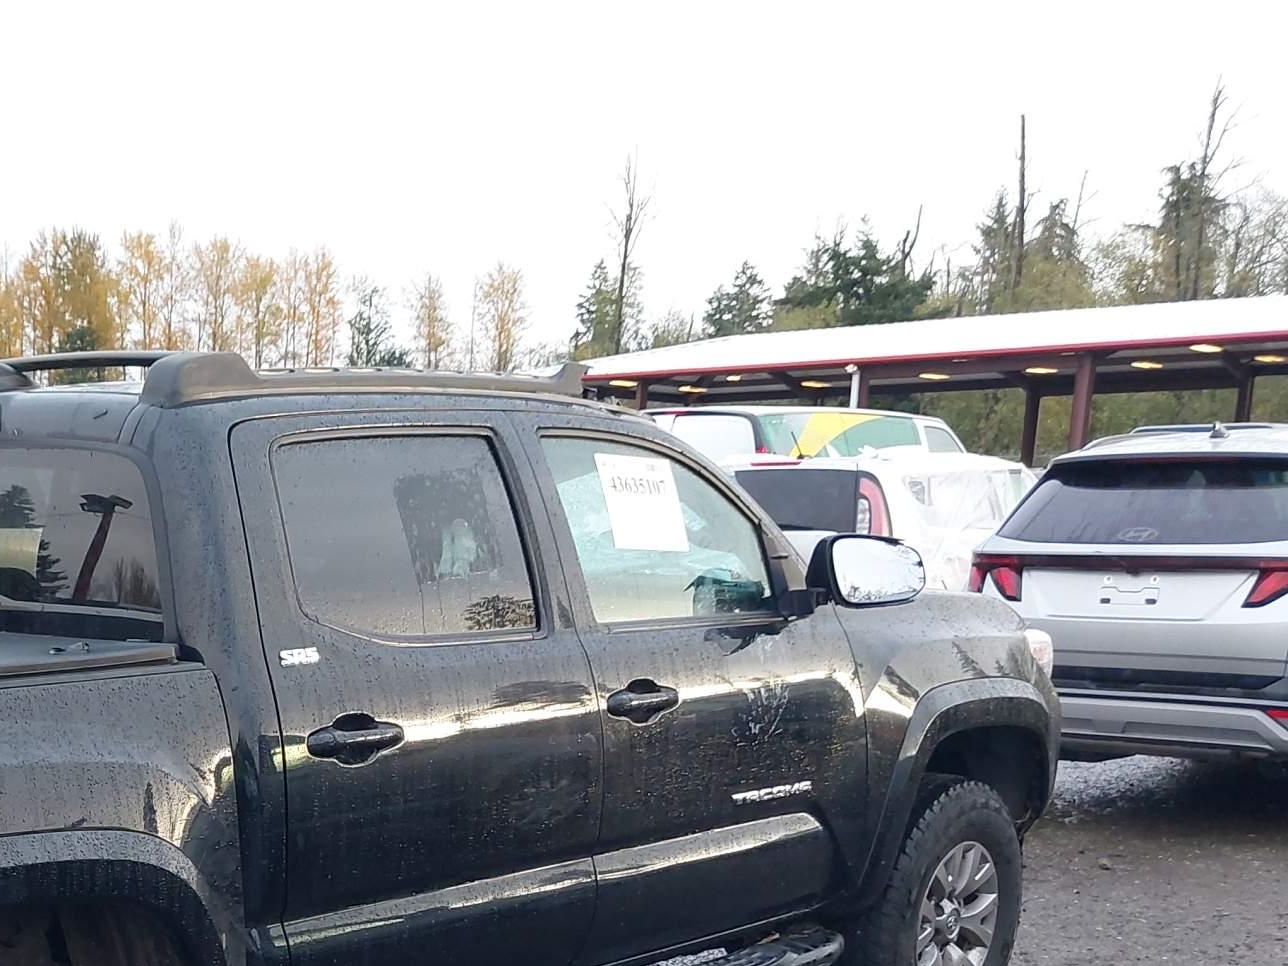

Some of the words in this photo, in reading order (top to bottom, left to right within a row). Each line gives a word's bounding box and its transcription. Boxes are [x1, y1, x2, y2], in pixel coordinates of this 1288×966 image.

[608, 475, 666, 495] 43635107
[279, 646, 320, 666] SR5
[731, 780, 812, 805] TACOMA
